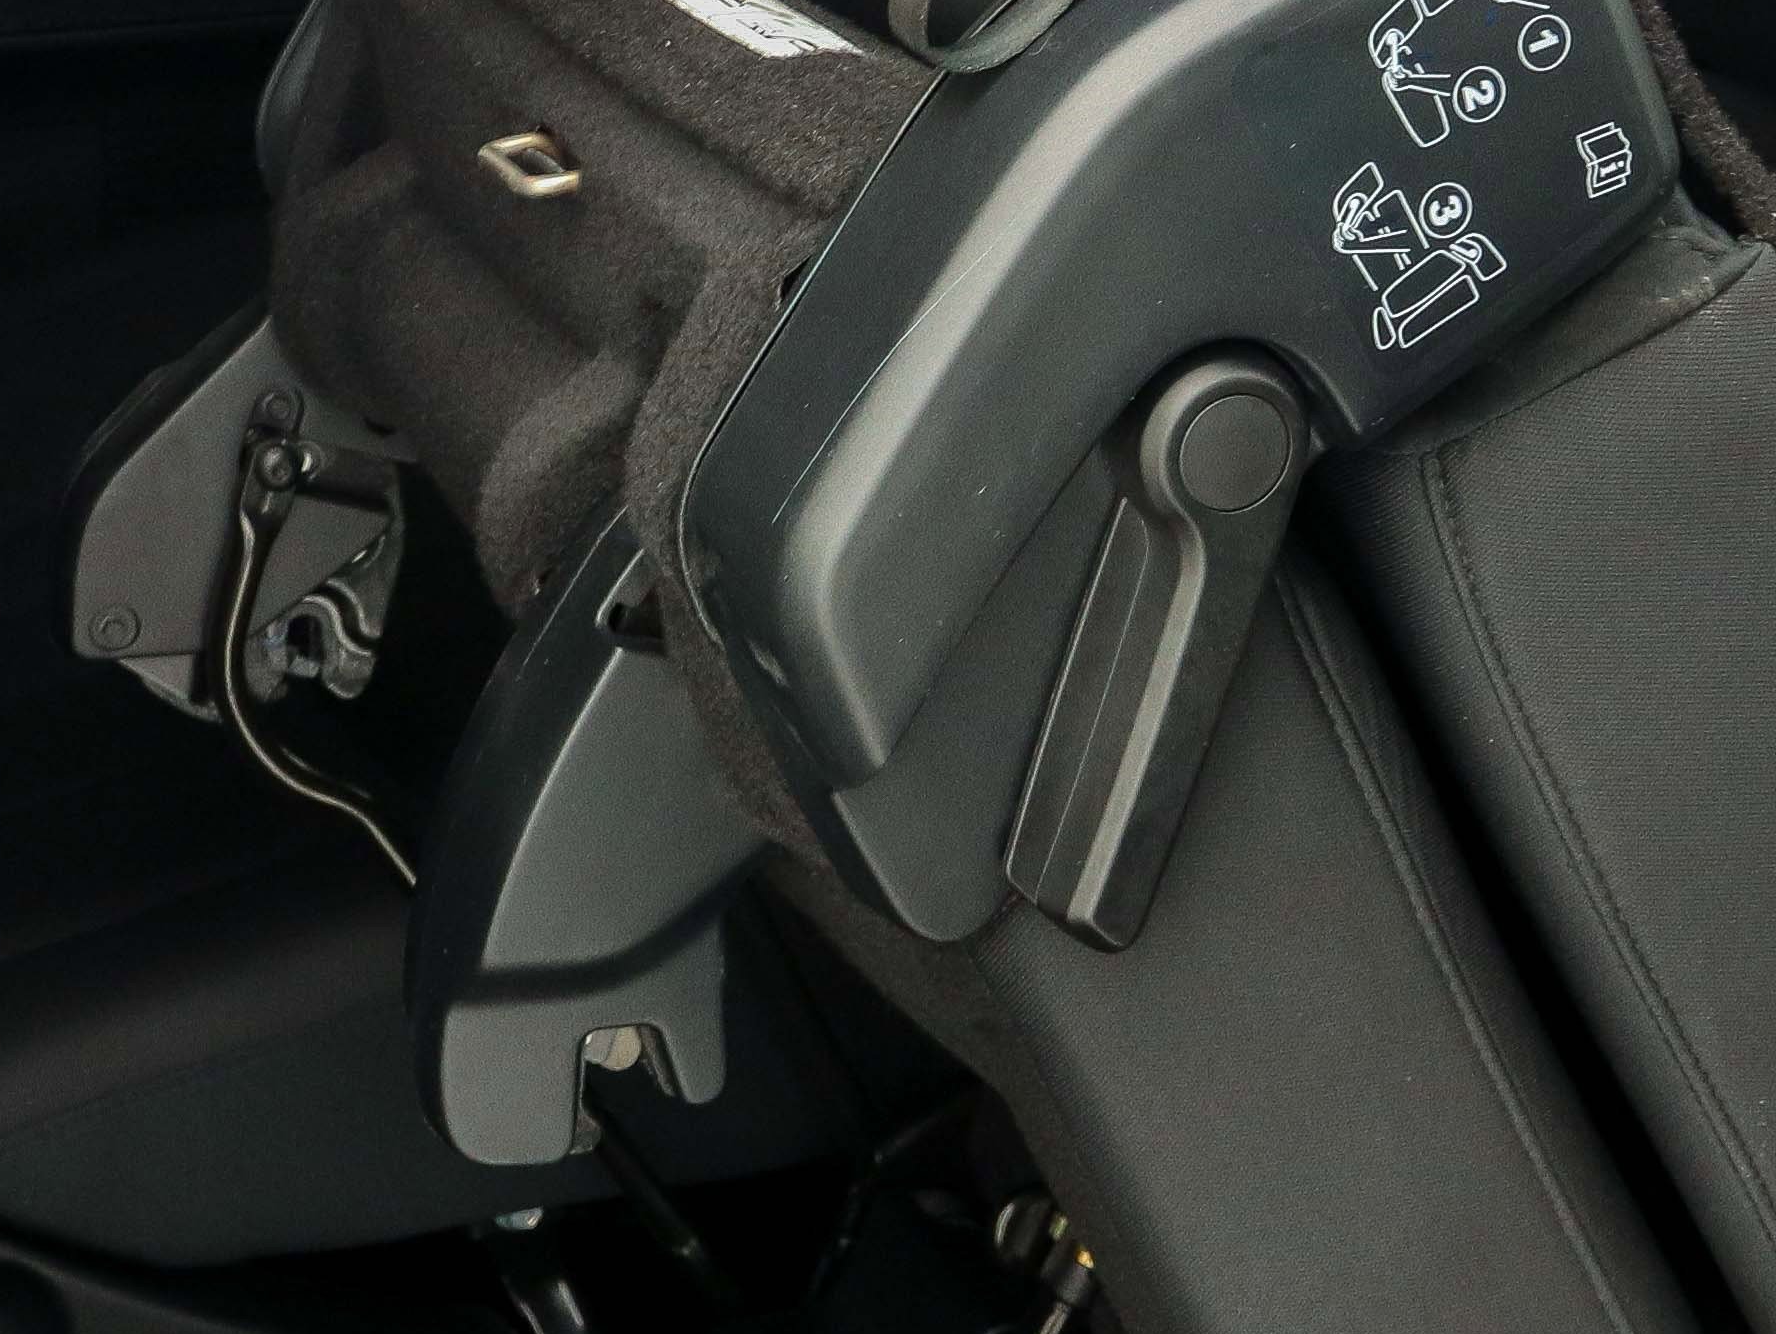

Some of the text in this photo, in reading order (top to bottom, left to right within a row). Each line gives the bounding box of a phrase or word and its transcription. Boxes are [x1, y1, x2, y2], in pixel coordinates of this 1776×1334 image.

[1527, 27, 1560, 54] 1
[1463, 79, 1495, 112] 2
[1429, 194, 1461, 225] 3
